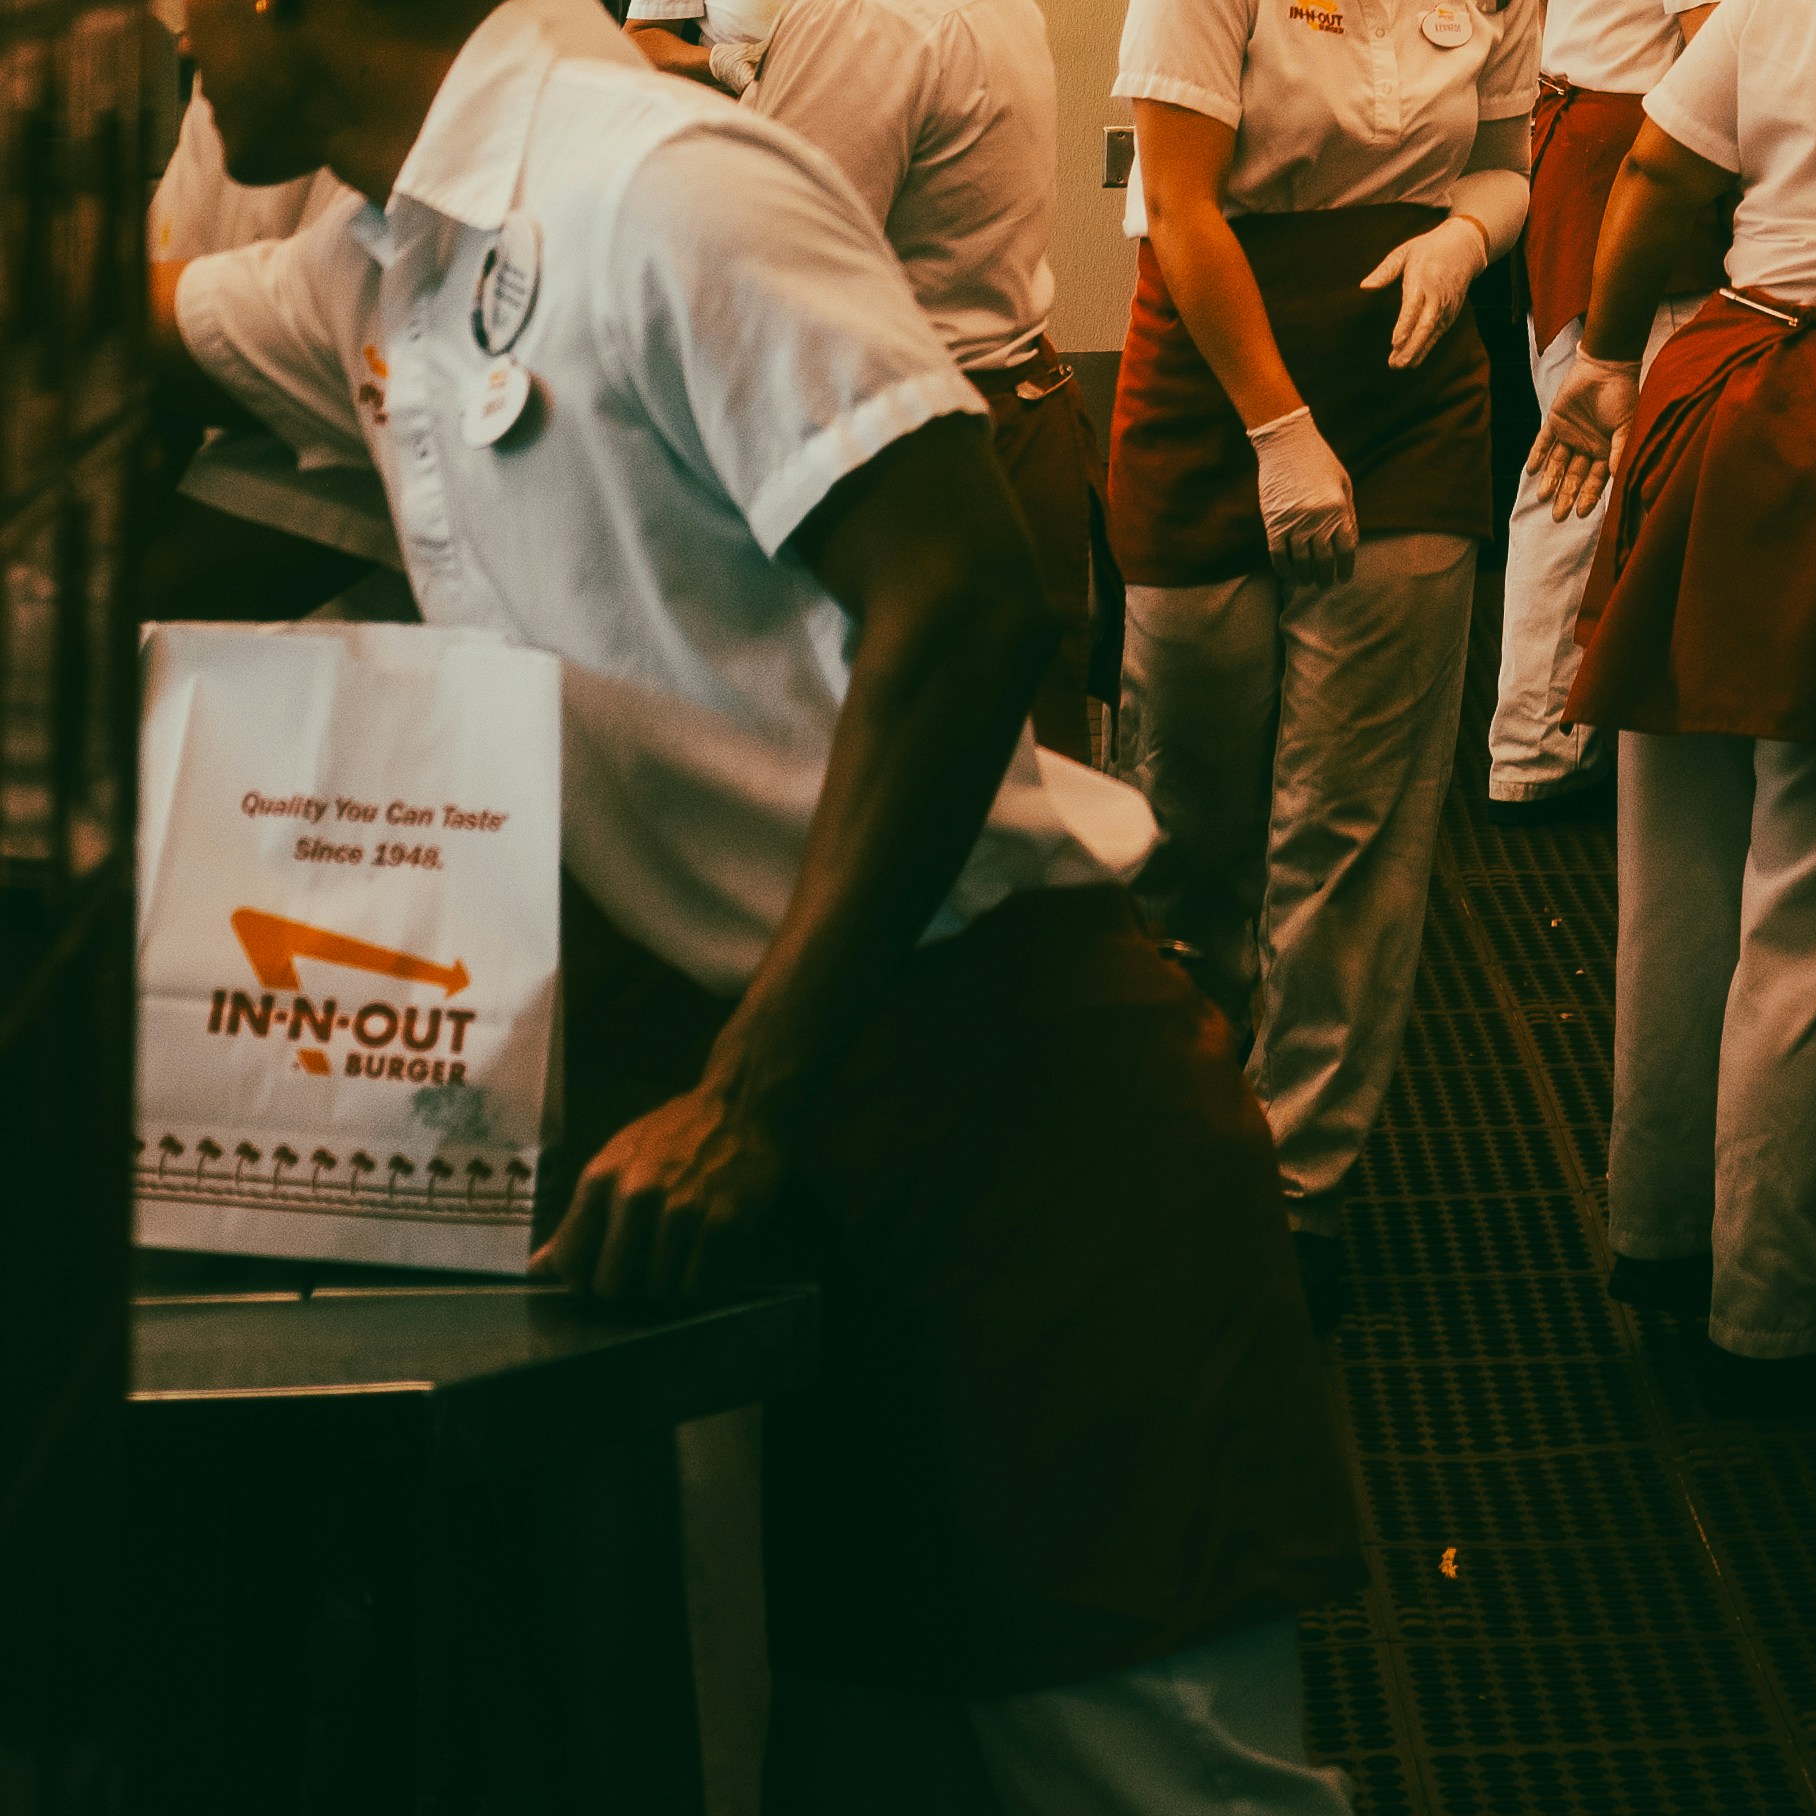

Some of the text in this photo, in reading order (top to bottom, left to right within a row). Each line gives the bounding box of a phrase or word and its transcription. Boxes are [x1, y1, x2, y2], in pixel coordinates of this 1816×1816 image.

[1289, 6, 1344, 27] IN-N-OUT
[240, 788, 509, 832] Quality You Can Taste
[293, 836, 364, 865] Since
[207, 989, 477, 1053] IN-N-OUT
[344, 1052, 467, 1087] BURGER
